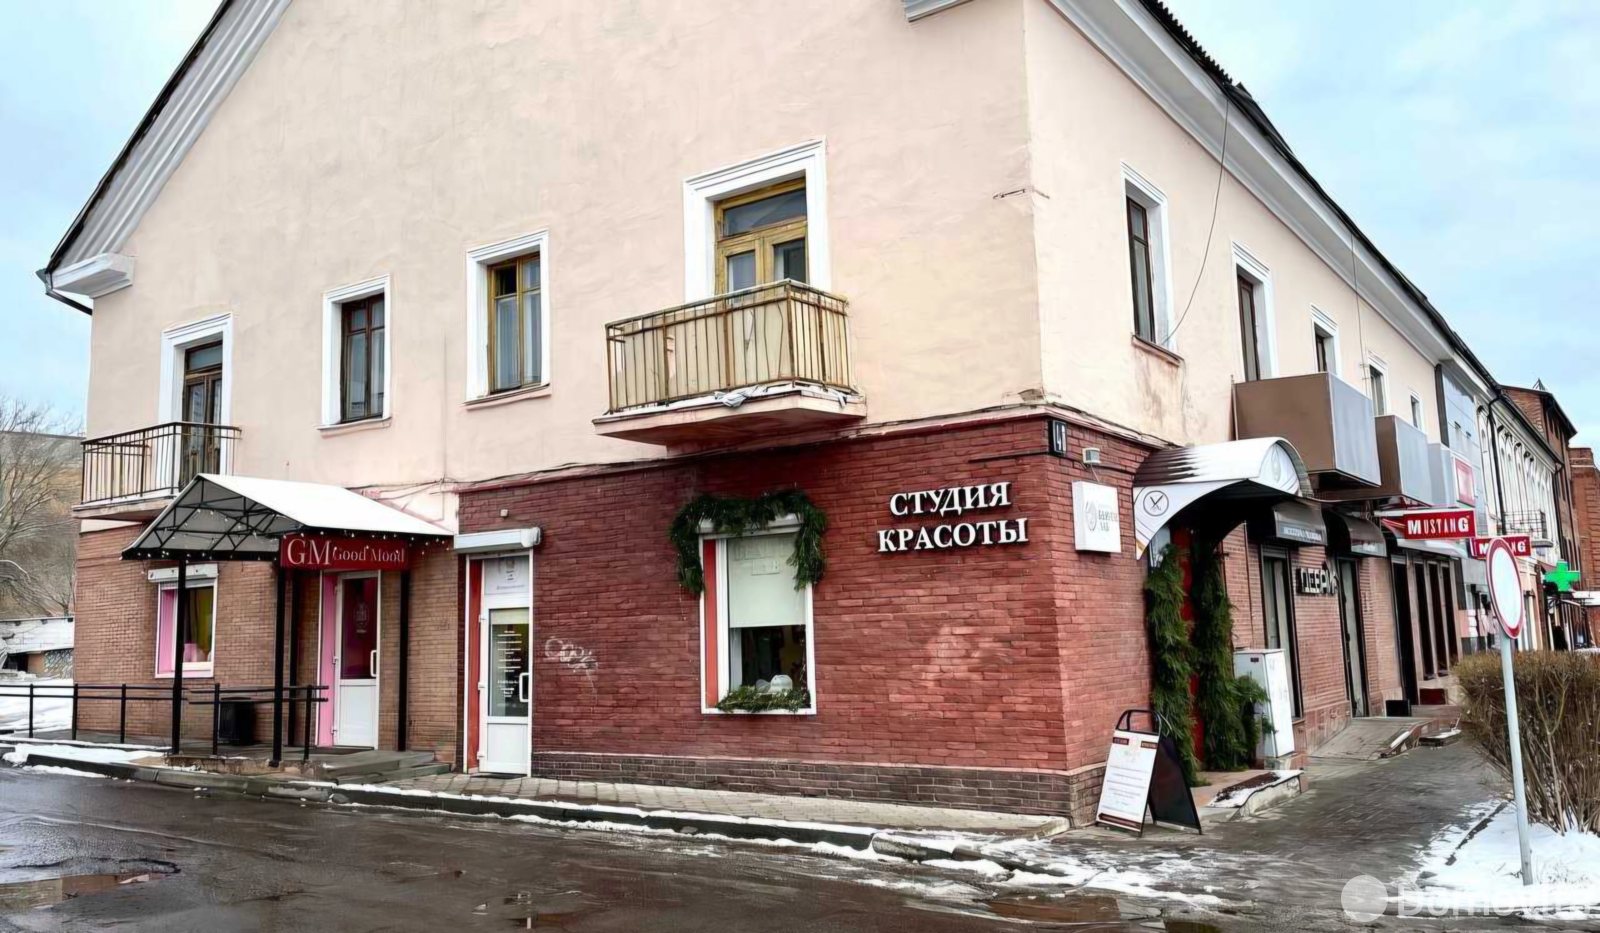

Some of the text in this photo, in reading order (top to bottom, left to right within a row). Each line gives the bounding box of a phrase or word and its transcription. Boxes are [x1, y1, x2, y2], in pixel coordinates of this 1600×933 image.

[890, 482, 1012, 517] СТУДИЯ
[877, 517, 1029, 552] КРАСОТЫ
[1407, 517, 1469, 535] MUSTANG
[287, 538, 331, 566] GM
